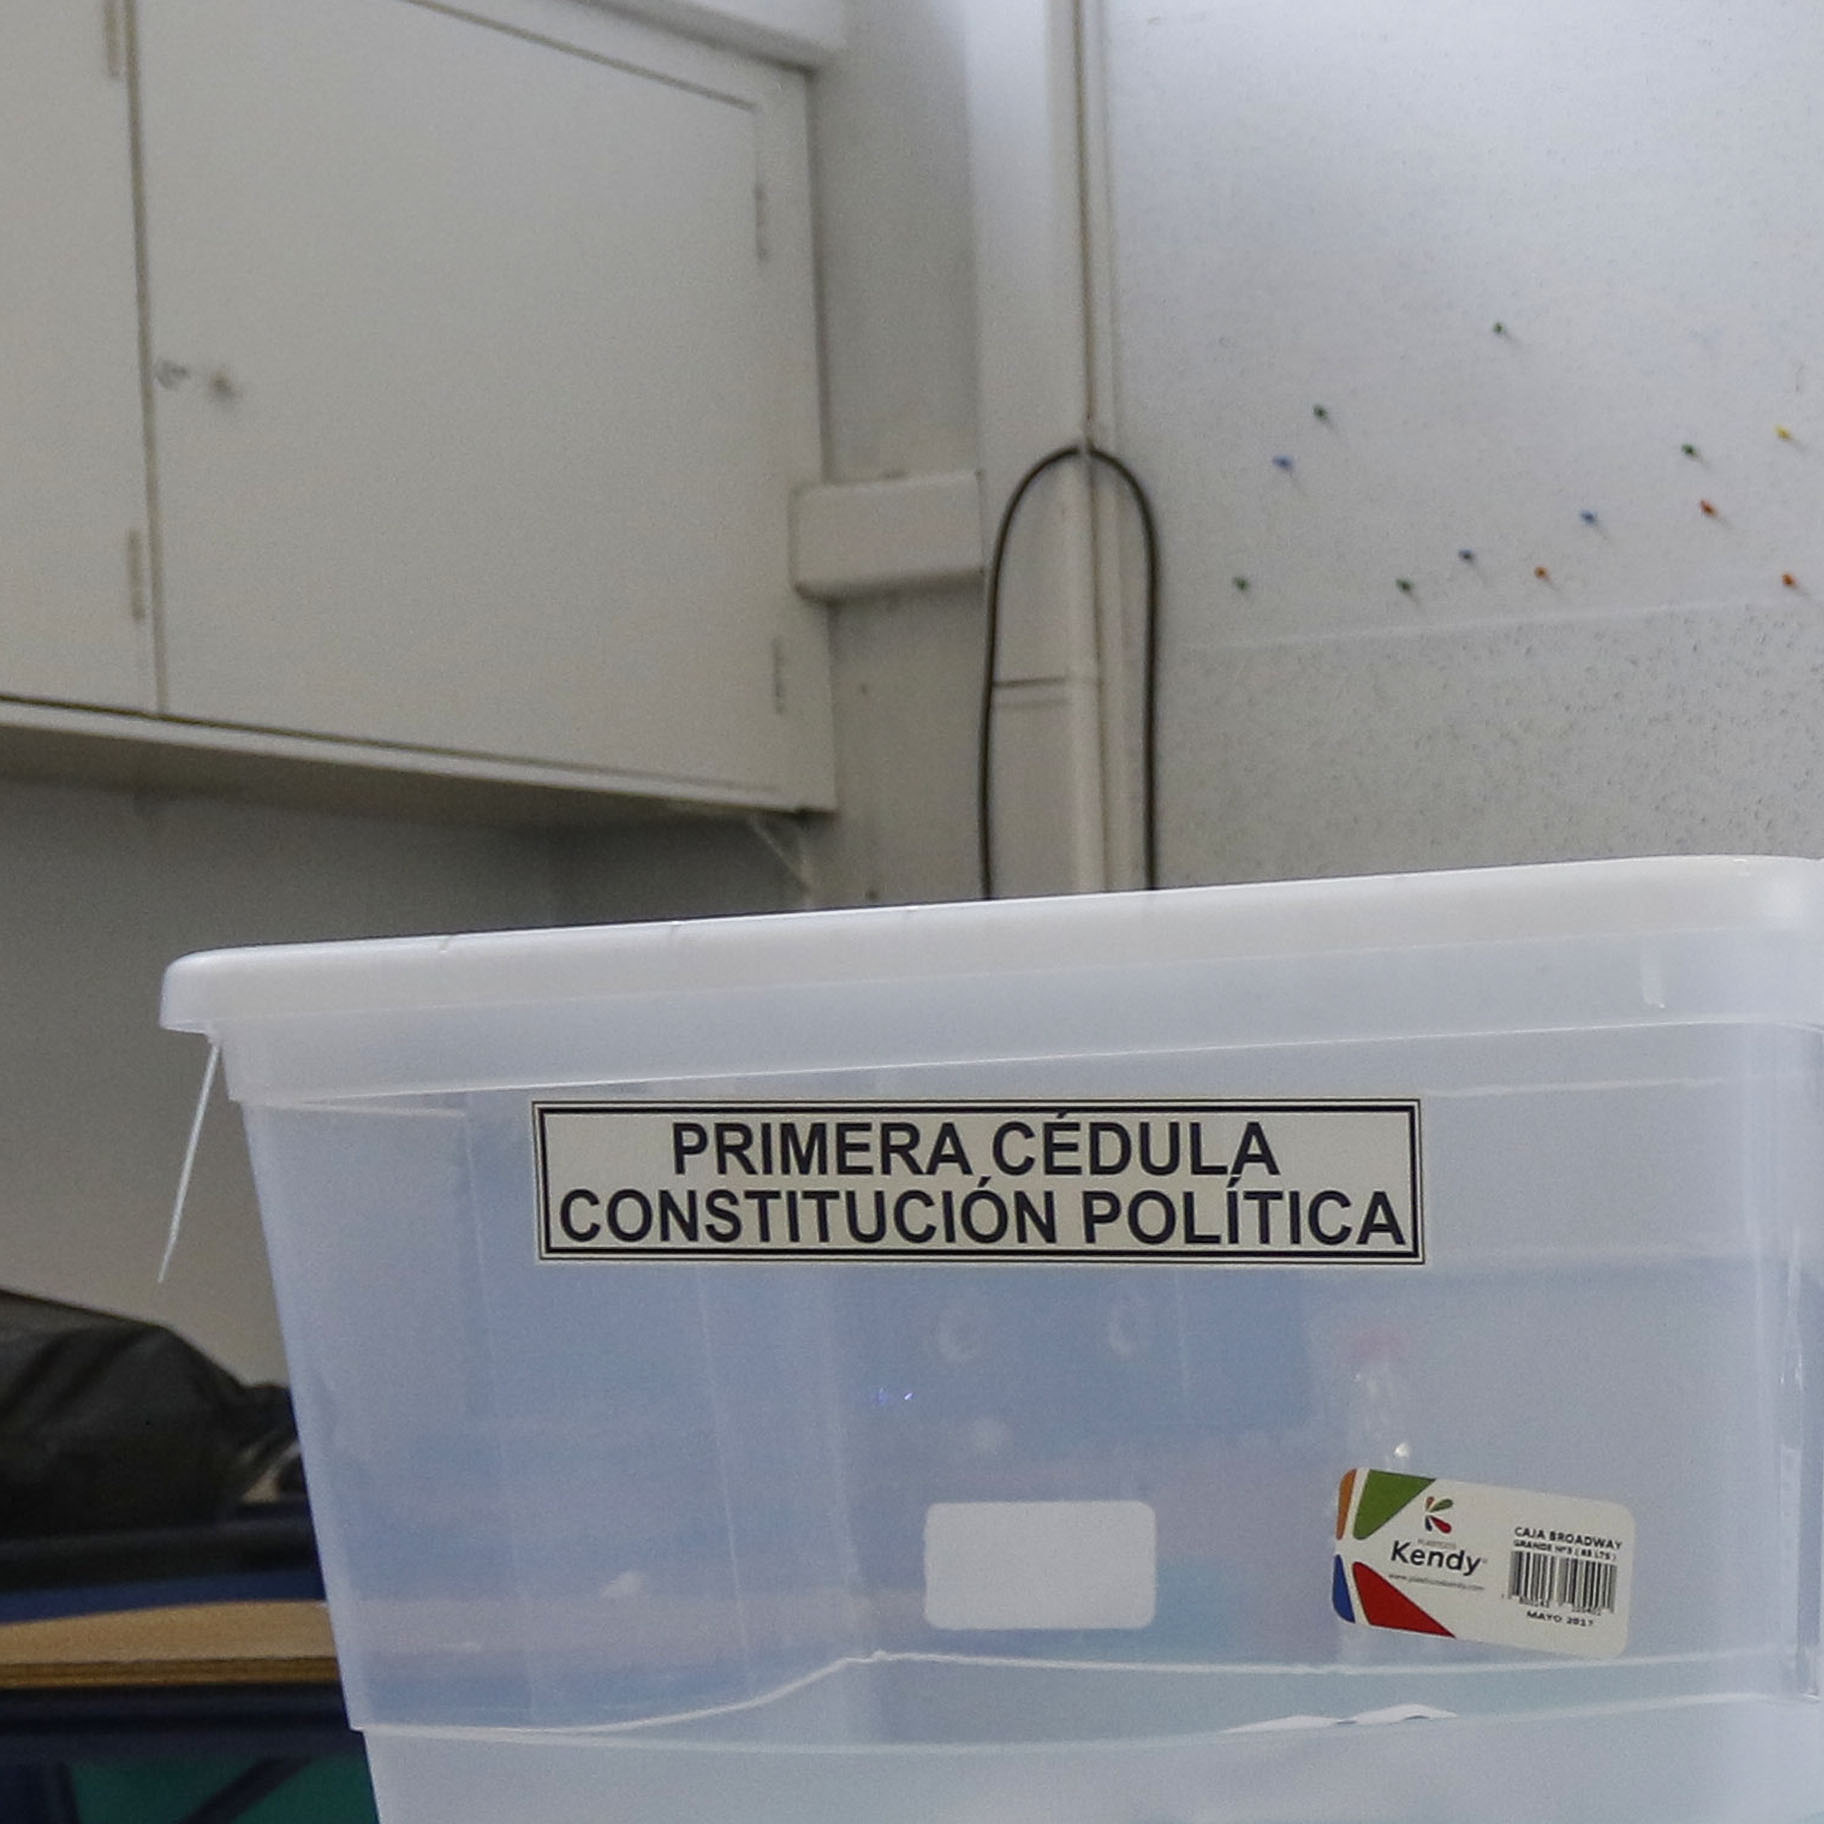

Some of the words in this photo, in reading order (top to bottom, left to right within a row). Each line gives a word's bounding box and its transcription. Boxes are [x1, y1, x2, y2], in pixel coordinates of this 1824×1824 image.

[672, 1121, 974, 1176] PRIMERA
[992, 1109, 1281, 1176] CÉDULA
[559, 1175, 1057, 1245] CONSTITUCIÓN
[1082, 1176, 1407, 1246] POLÍTICA
[1514, 1526, 1546, 1540] CAJA
[1549, 1530, 1622, 1549] BROADWAY
[1390, 1540, 1482, 1577] Kendy
[1527, 1610, 1562, 1623] MAYO
